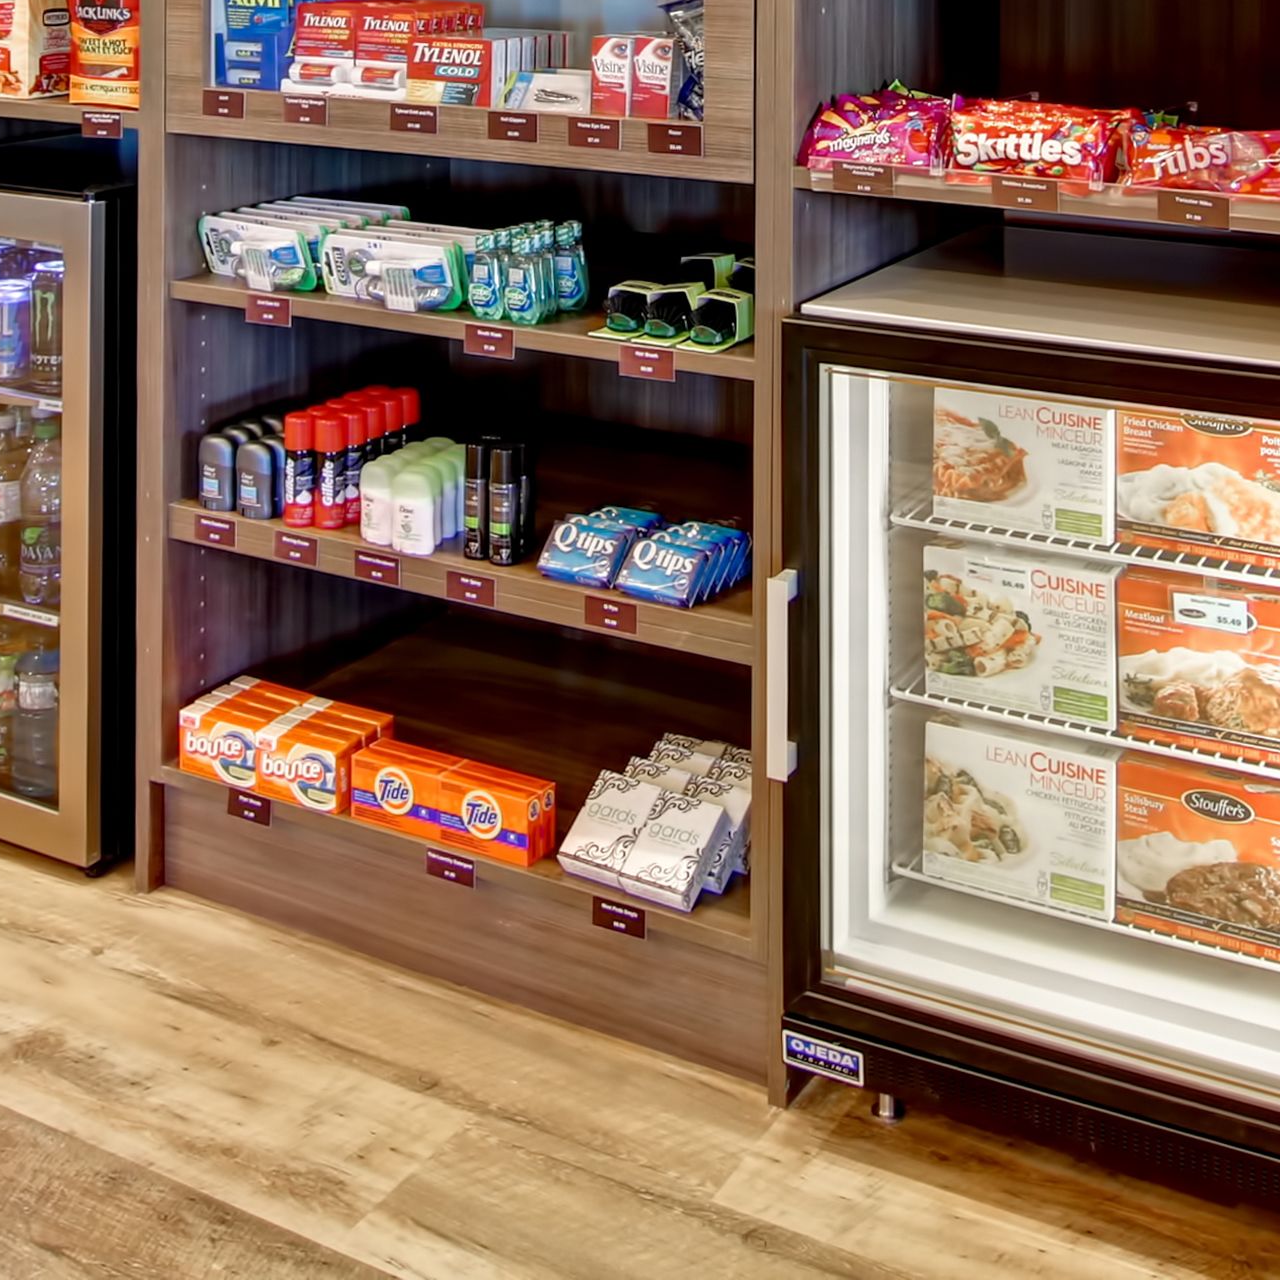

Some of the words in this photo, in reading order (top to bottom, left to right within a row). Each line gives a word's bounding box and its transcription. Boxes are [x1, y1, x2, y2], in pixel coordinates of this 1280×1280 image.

[303, 13, 348, 28] TYLENOL
[363, 16, 410, 32] TYLENOL
[413, 42, 482, 65] TYLENOL
[594, 58, 626, 73] Visine
[635, 58, 668, 74] Visine
[438, 67, 475, 76] COLD
[956, 133, 1082, 166] Skittles
[998, 404, 1034, 421] LEAN
[1036, 406, 1102, 430] CUISINE
[1124, 417, 1146, 428] Fried
[1148, 419, 1183, 432] Chicken
[1036, 425, 1102, 446] MINCEUR
[1124, 426, 1152, 438] Breast
[285, 458, 295, 504] Gillette
[322, 461, 334, 506] Gillette
[1030, 569, 1106, 599] CUISINE
[1031, 591, 1106, 616] MINCEUR
[1125, 608, 1165, 624] Meatloaf
[186, 732, 241, 757] bounce
[262, 753, 321, 779] bounce
[986, 744, 1027, 767] LEAN
[1030, 752, 1107, 786] CUISINE
[379, 776, 410, 802] Tide
[1030, 773, 1106, 803] MINCEUR
[586, 800, 639, 825] gards
[1124, 793, 1165, 811] Salisbury
[1124, 803, 1148, 816] Steak
[1189, 793, 1246, 819] Stouffer's
[465, 802, 499, 828] Tide
[648, 819, 700, 846] gards
[791, 1038, 854, 1068] OJEDA
